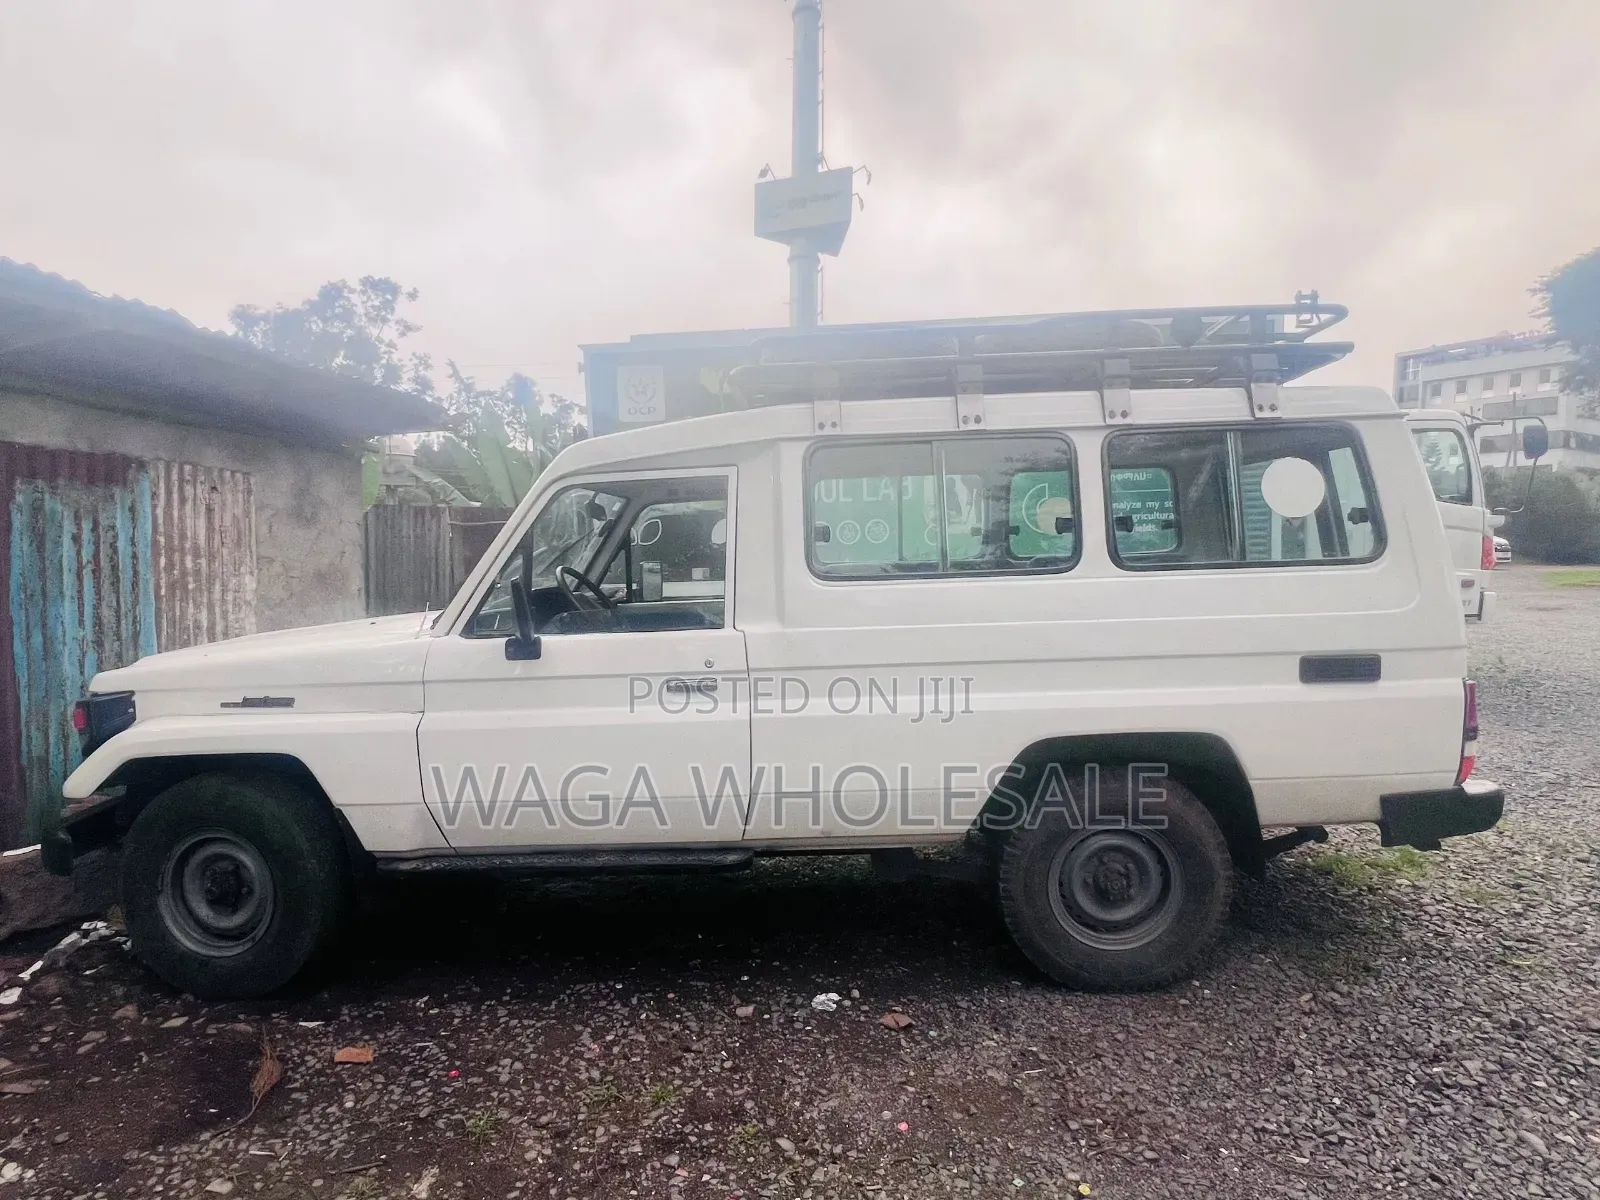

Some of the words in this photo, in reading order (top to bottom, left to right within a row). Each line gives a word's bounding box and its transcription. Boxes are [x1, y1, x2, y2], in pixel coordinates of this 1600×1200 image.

[628, 406, 656, 416] OCP
[1112, 501, 1141, 511] nalyze
[1146, 501, 1159, 510] my
[1132, 511, 1174, 523] gricultura
